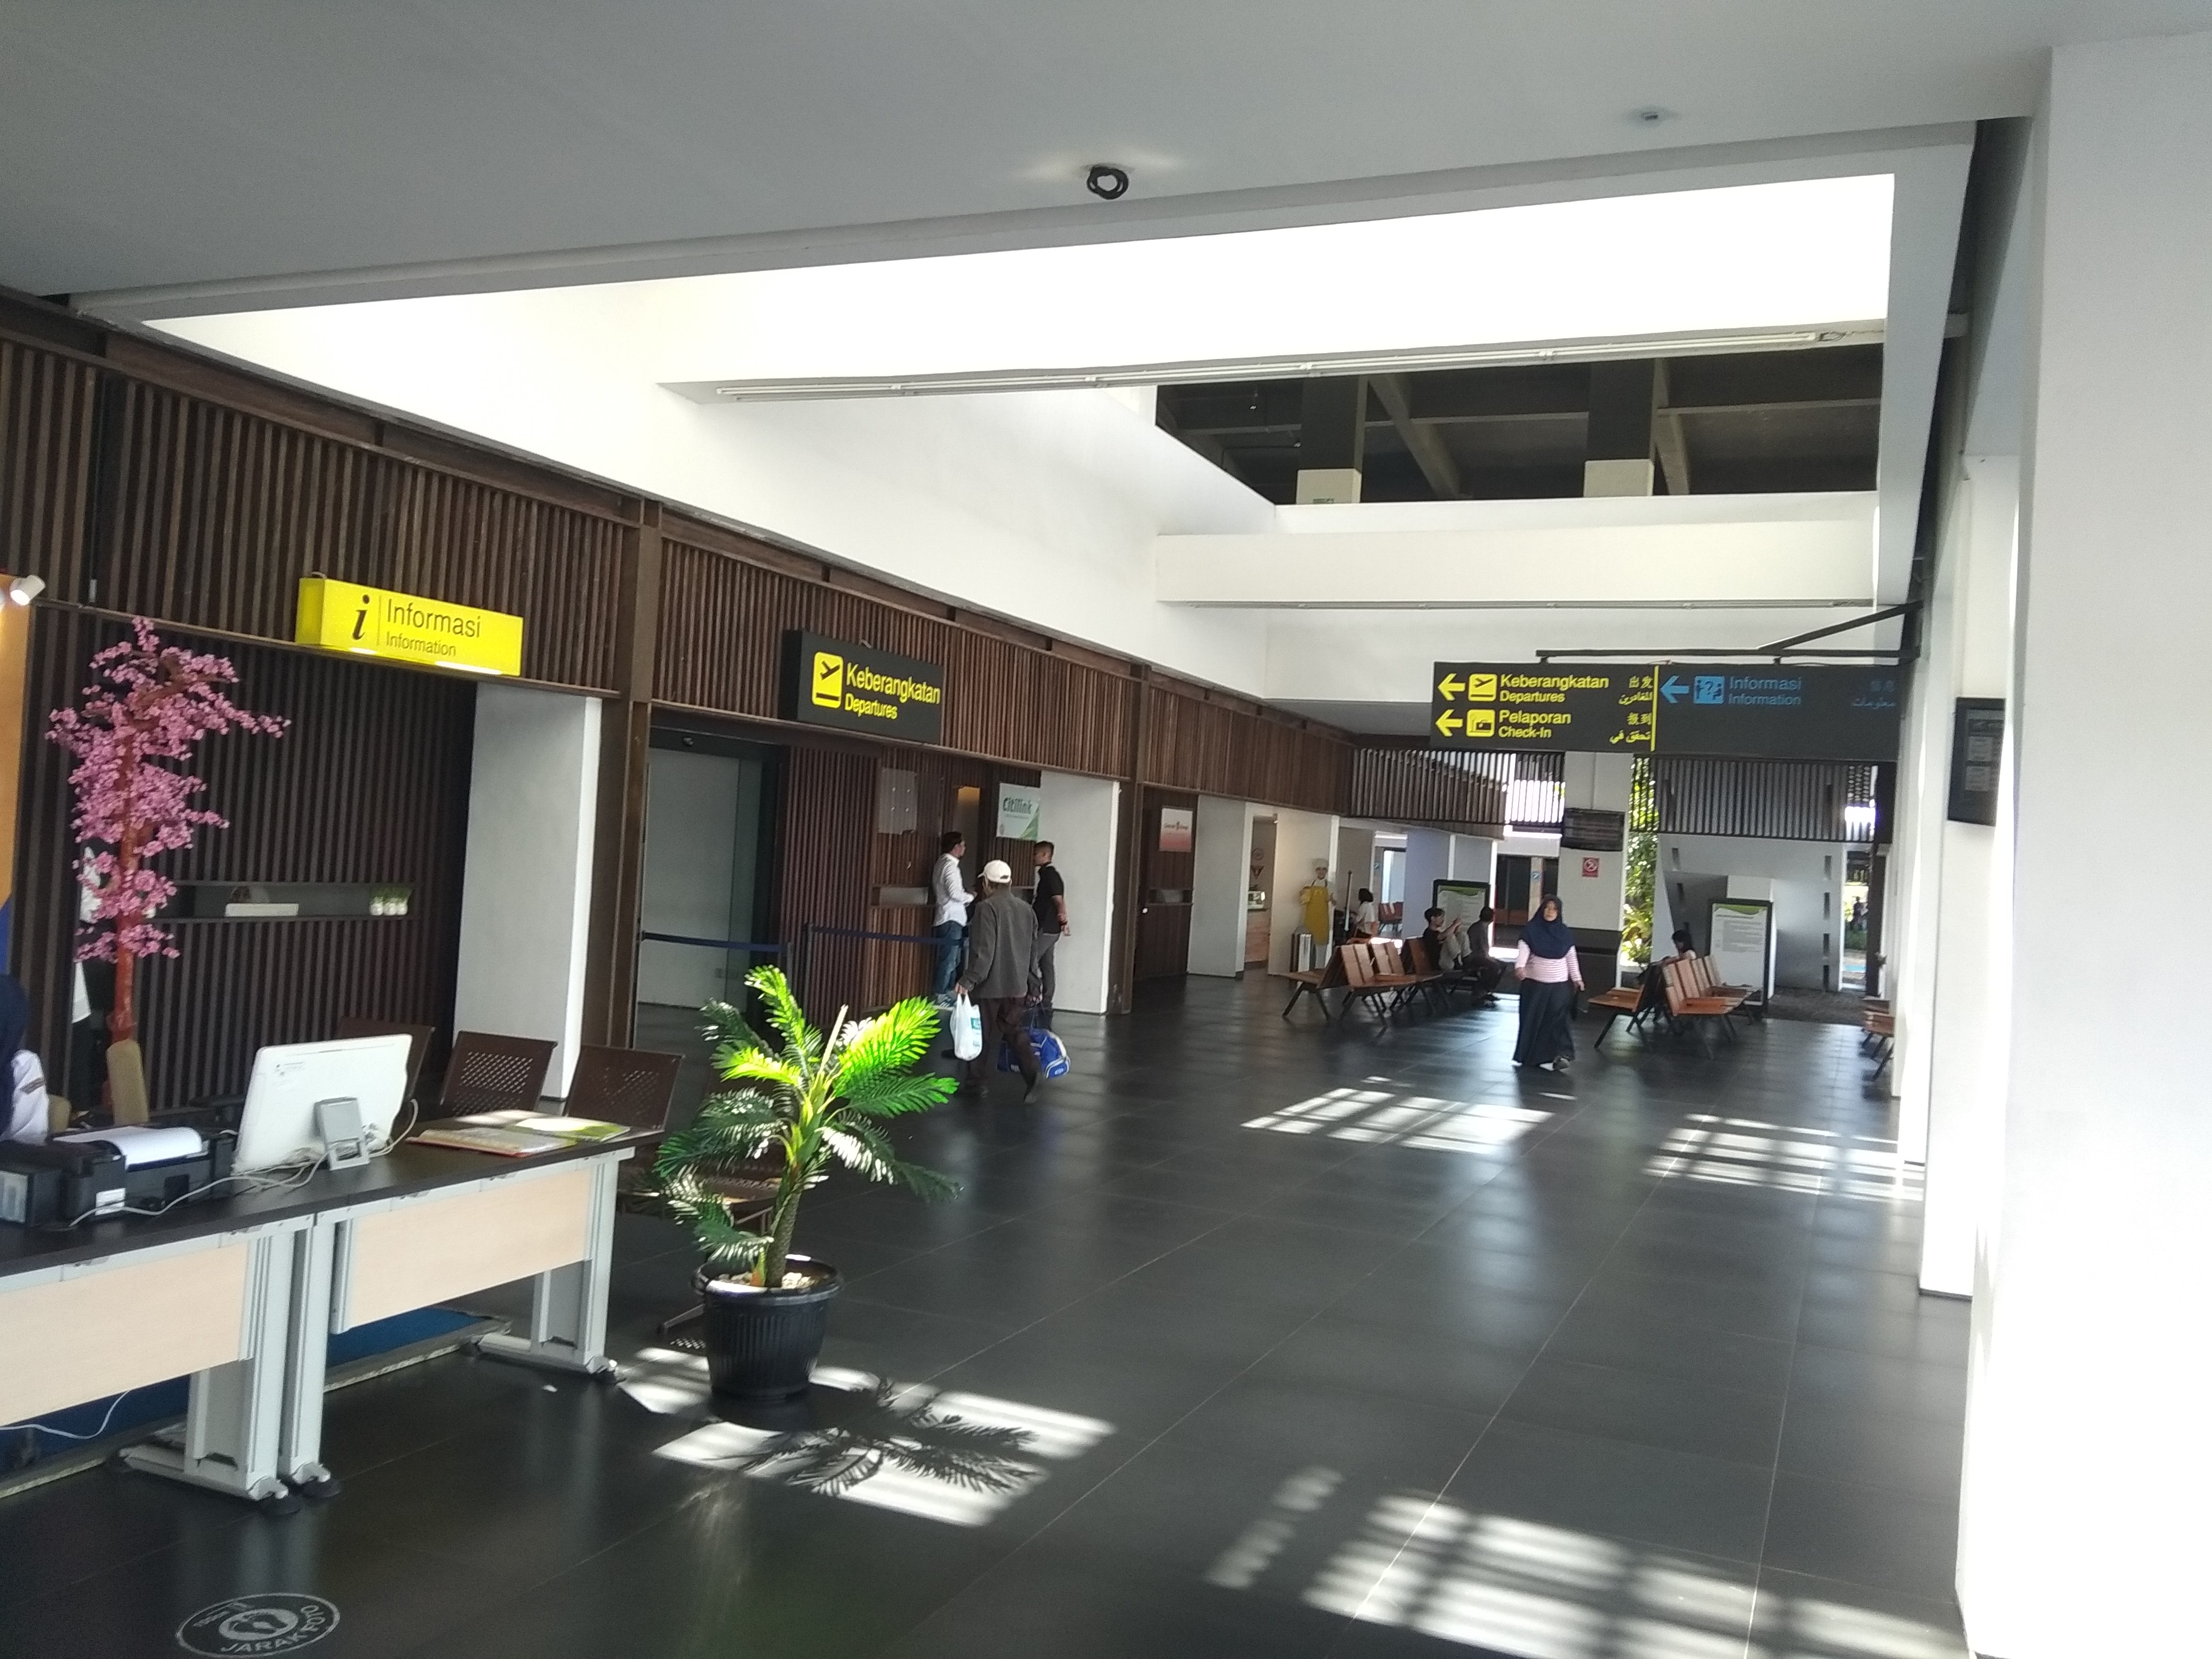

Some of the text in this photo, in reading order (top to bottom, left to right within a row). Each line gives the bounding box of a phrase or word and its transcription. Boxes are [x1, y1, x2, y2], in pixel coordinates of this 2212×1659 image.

[352, 594, 370, 640] i
[387, 599, 481, 638] Informasi
[386, 631, 456, 656] Information
[847, 663, 941, 704] Keberangkatan
[1501, 674, 1609, 691] Keberangkatan
[1730, 677, 1802, 690] Informasi
[844, 693, 897, 719] Departures
[1499, 690, 1565, 703] Departures
[1728, 693, 1800, 706] Information
[1499, 710, 1571, 726] Pelaporan
[1498, 726, 1552, 739] Check-In
[221, 1632, 307, 1653] JARAK
